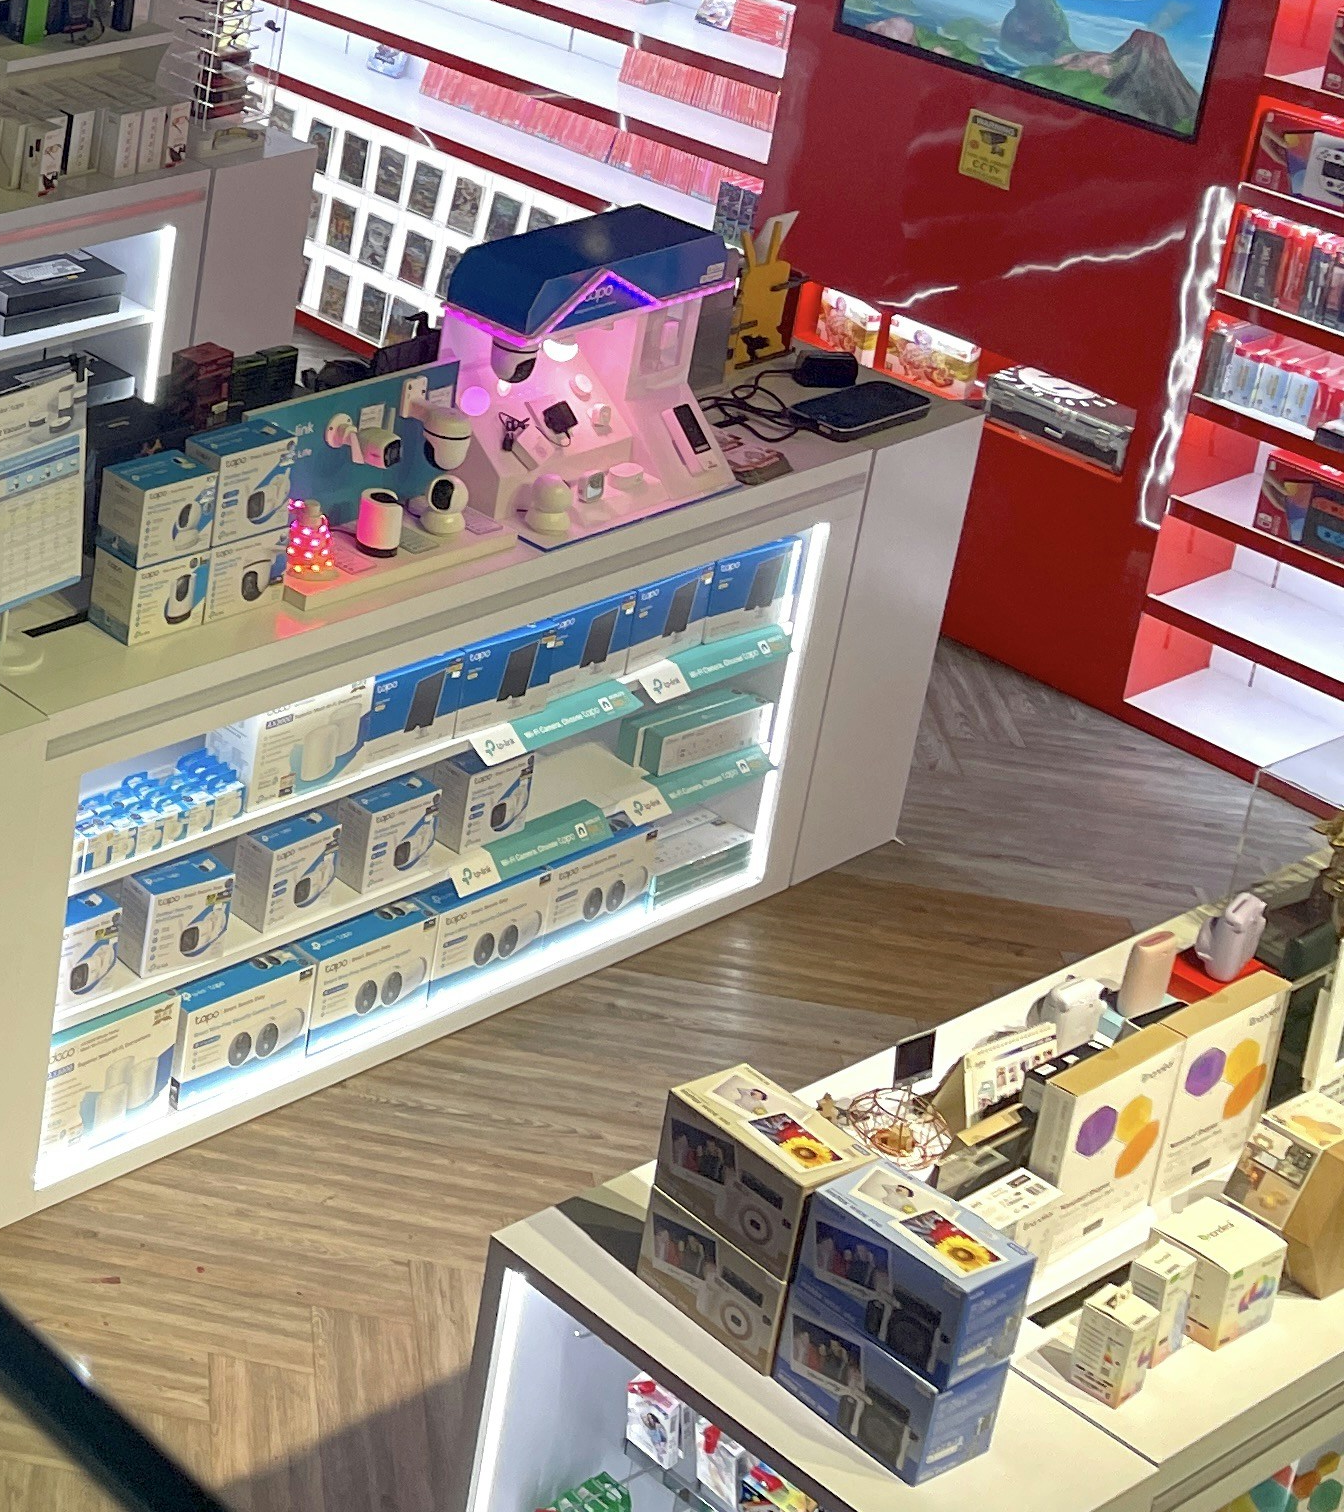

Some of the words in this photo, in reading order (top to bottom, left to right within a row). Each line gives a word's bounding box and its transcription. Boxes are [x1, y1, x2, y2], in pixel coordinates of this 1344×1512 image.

[376, 680, 398, 694] tapo
[157, 895, 181, 906] tapo
[195, 1010, 220, 1025] tapo
